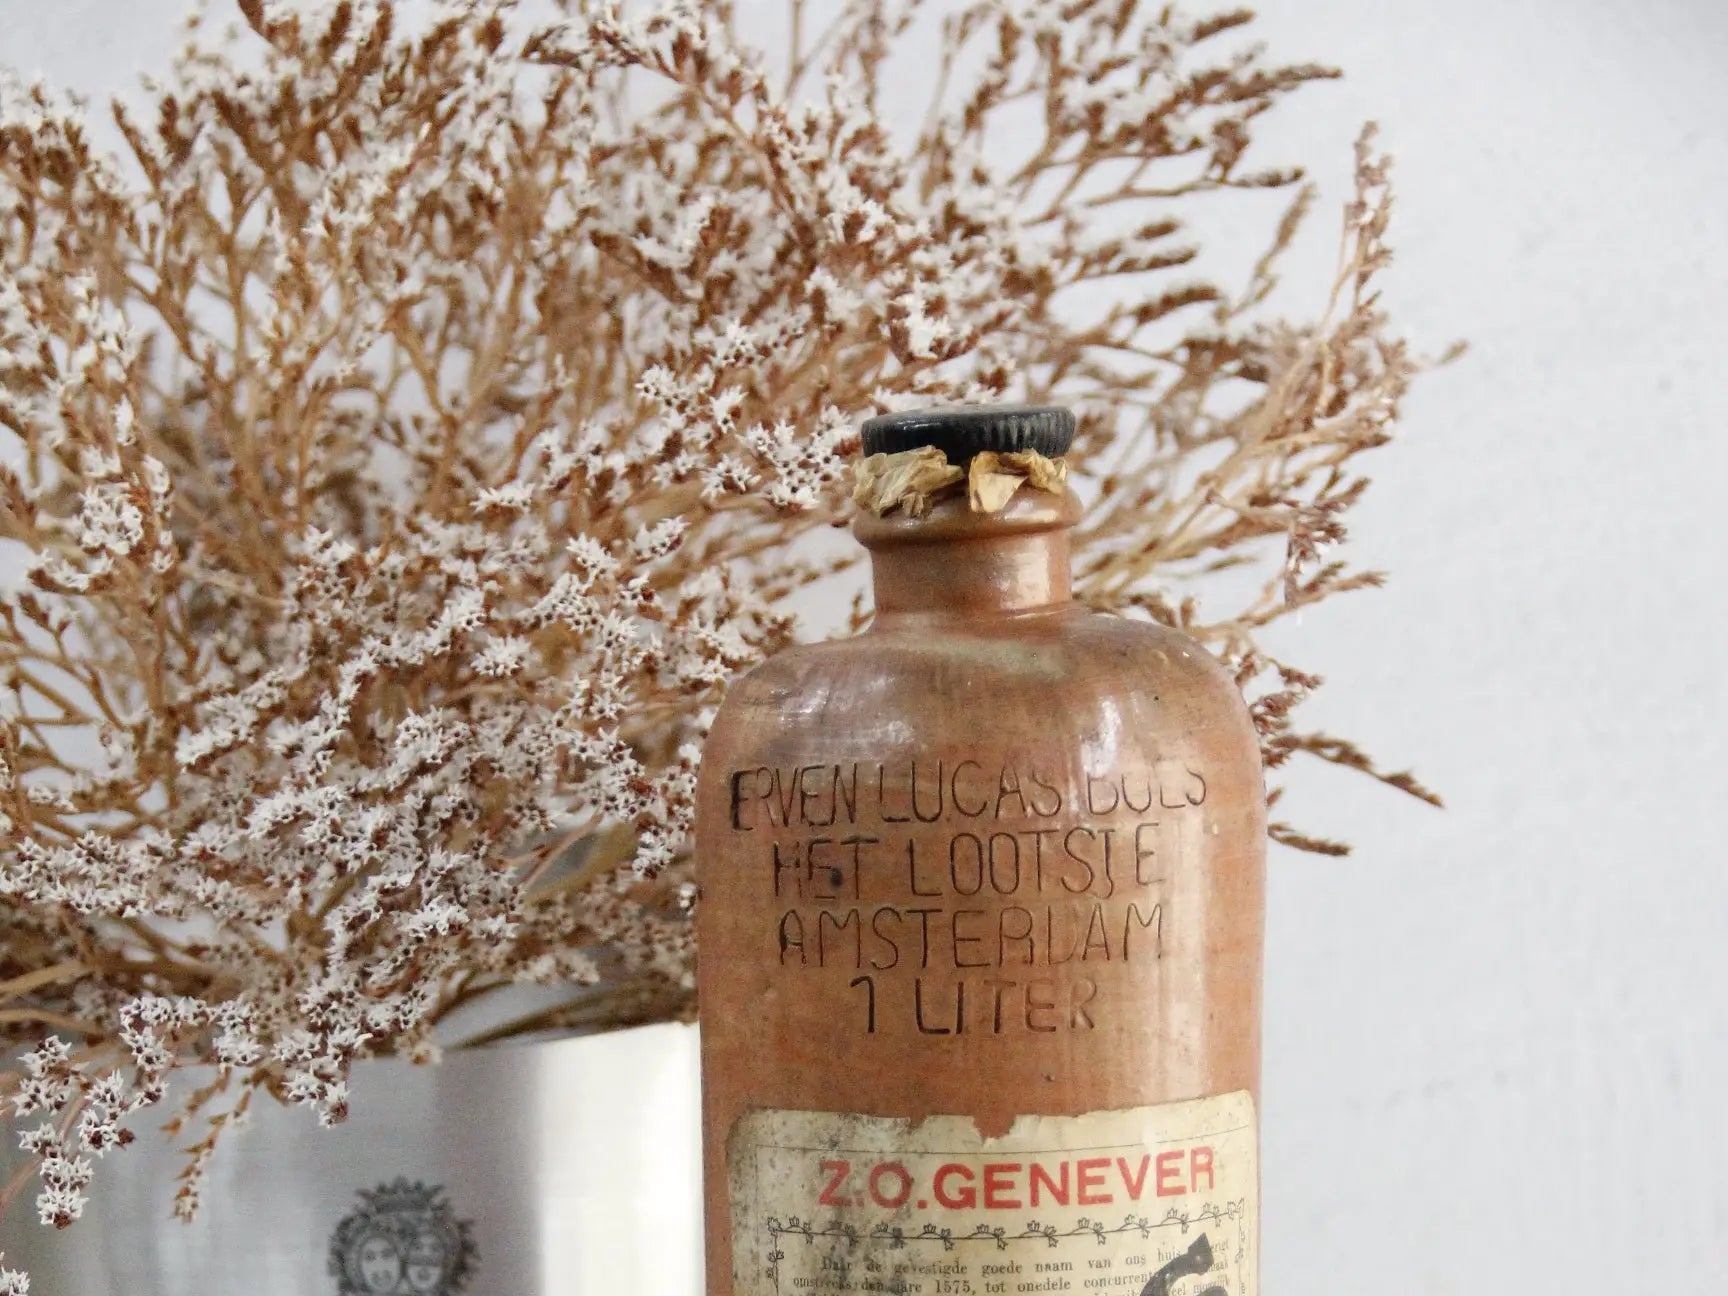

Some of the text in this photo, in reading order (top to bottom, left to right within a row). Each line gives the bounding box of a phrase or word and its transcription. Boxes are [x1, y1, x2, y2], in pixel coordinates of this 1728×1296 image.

[729, 763, 857, 831] ERVEN
[879, 760, 1062, 823] LUCAS
[772, 836, 879, 899] HET
[779, 902, 1164, 970] AMSTERDAM
[849, 975, 1100, 1034] 1 LITER
[936, 1280, 977, 1296] 1575,
[985, 1281, 1005, 1293] tot
[1017, 1280, 1071, 1292] onedele
[982, 1258, 1022, 1277] goede
[1035, 1261, 1073, 1273] naam
[1088, 1259, 1111, 1270] van
[1126, 1254, 1146, 1266] ons
